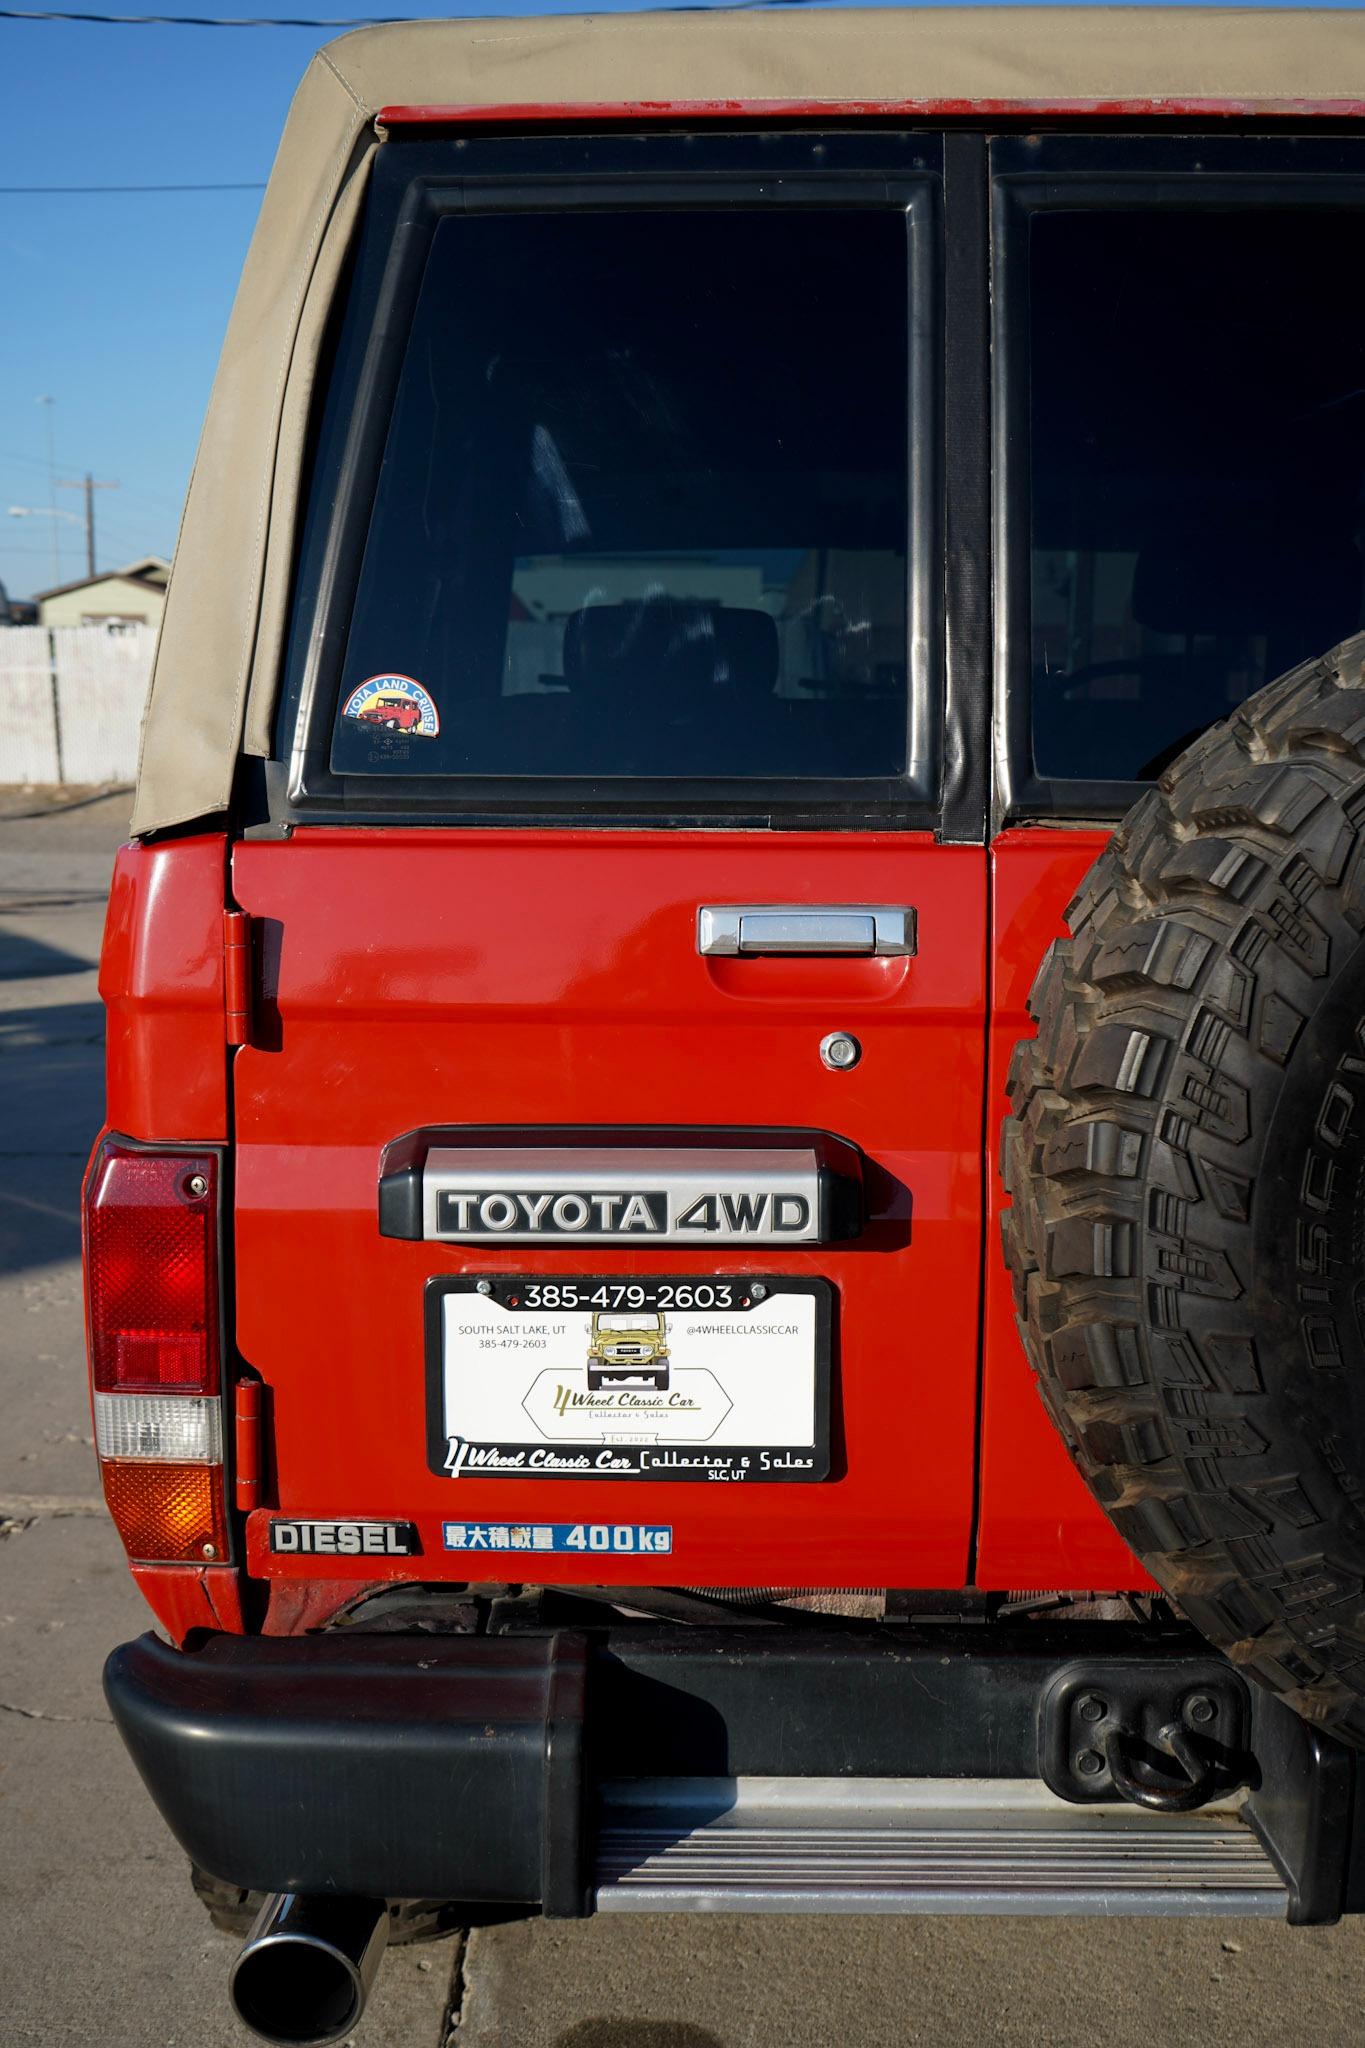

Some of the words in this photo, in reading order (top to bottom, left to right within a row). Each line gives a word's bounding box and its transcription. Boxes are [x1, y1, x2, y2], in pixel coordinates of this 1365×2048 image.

[348, 688, 373, 717] YOTA
[375, 679, 408, 692] LAND
[447, 1194, 657, 1231] TOYOTA
[674, 1192, 811, 1233] 4WD
[523, 1284, 733, 1308] 385-479-2603
[458, 1325, 494, 1335] SOUTH
[496, 1325, 520, 1335] SALT
[522, 1325, 550, 1336] LAKE,
[552, 1325, 566, 1335] UT
[686, 1325, 799, 1335] @4WHEELCLASSICCAR
[479, 1339, 547, 1349] 385-479-2603
[618, 1392, 664, 1406] Classic
[668, 1392, 695, 1407] Car
[528, 1448, 591, 1468] Classic
[595, 1449, 631, 1469] Car
[639, 1450, 733, 1470] Collector
[740, 1456, 751, 1468] &
[760, 1451, 814, 1471] Sales
[708, 1469, 730, 1482] SLC,
[731, 1469, 747, 1481] UT
[274, 1524, 409, 1555] DIESEL
[446, 1525, 554, 1549] 最大積載量
